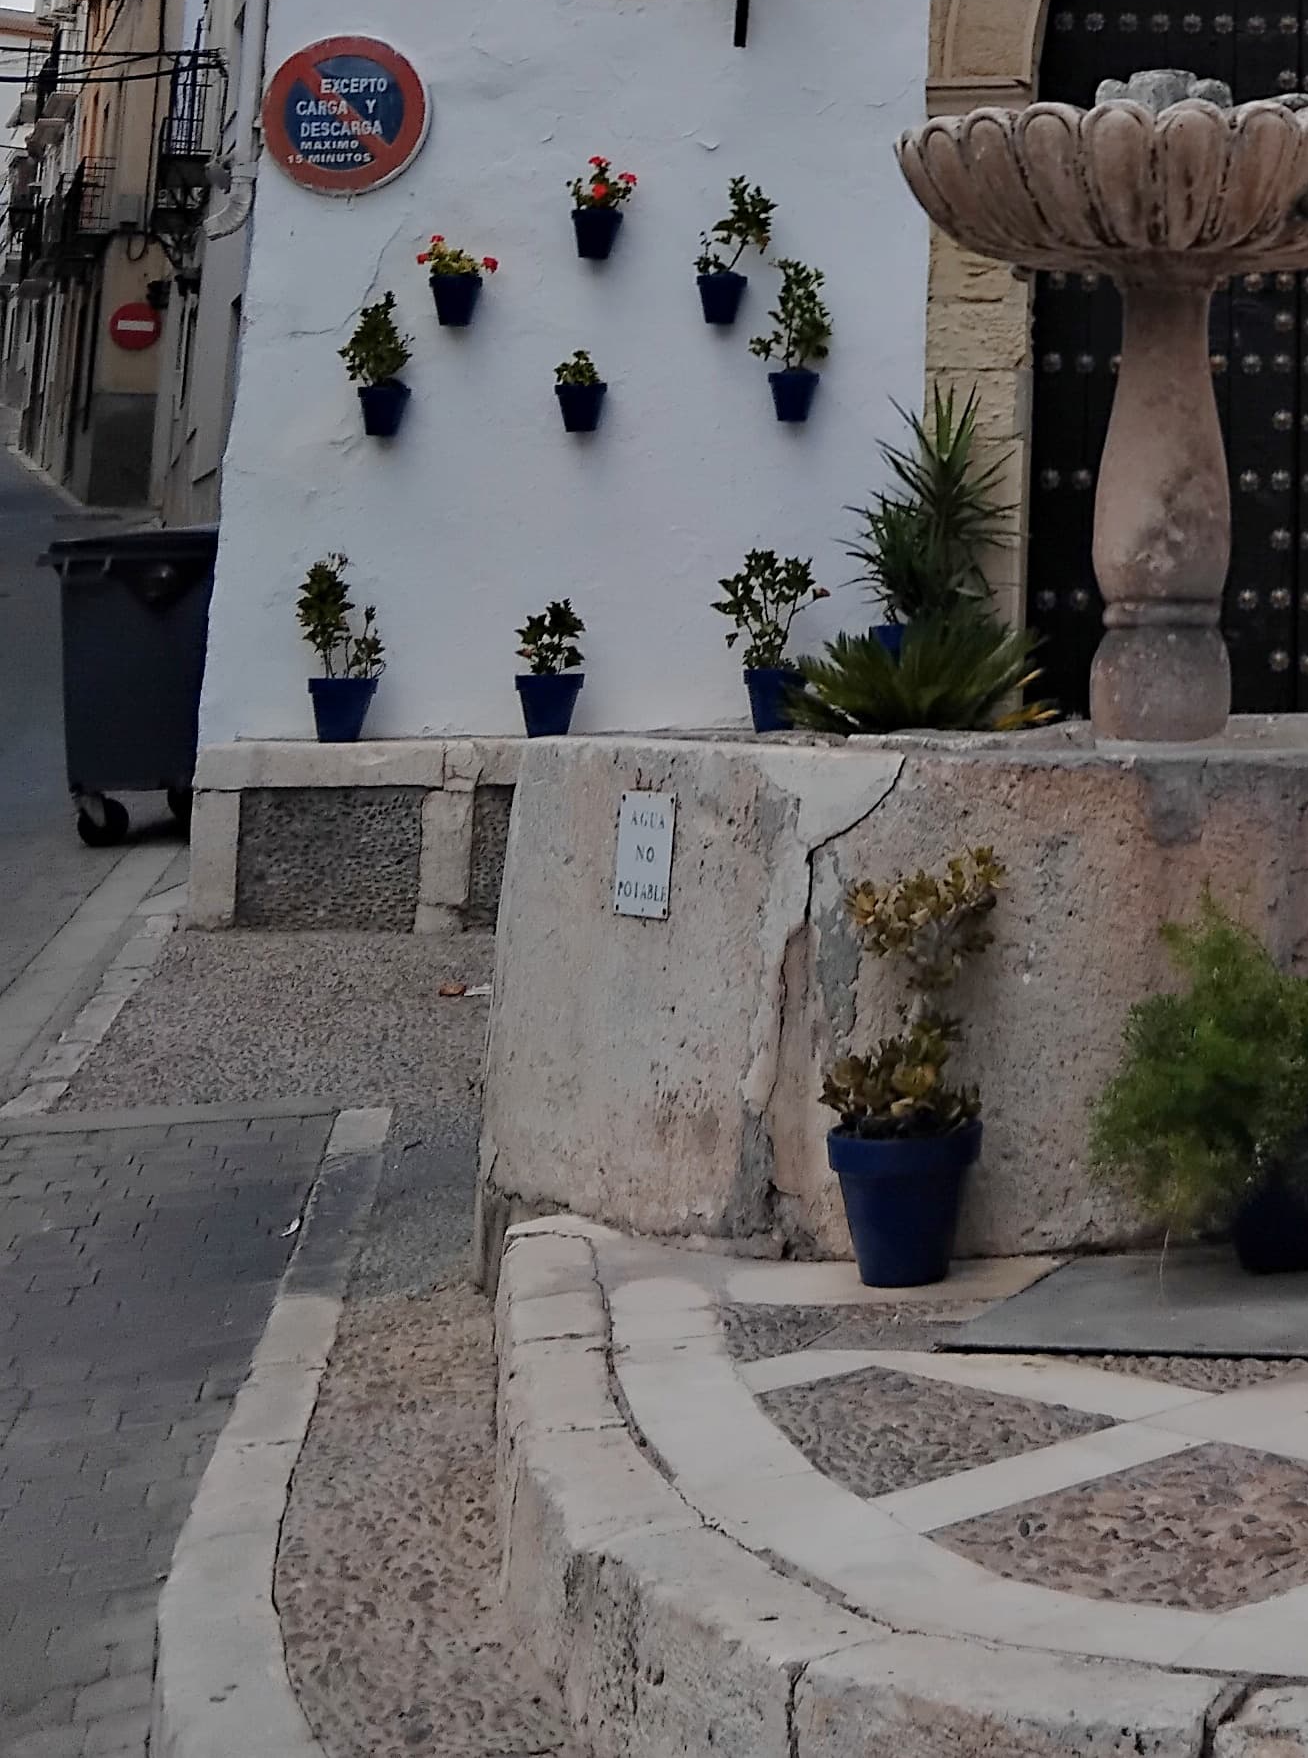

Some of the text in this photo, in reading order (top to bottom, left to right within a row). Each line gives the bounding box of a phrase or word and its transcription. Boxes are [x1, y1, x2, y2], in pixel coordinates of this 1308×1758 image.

[321, 78, 388, 94] EXCEPTO
[296, 99, 377, 116] CARGA Y
[300, 120, 383, 138] DESCARGA
[300, 140, 359, 150] MAXIMO
[287, 152, 372, 164] 15 MINUTOS
[631, 810, 665, 830] AGUA
[635, 844, 655, 863] NO
[617, 880, 666, 904] POTABLE
